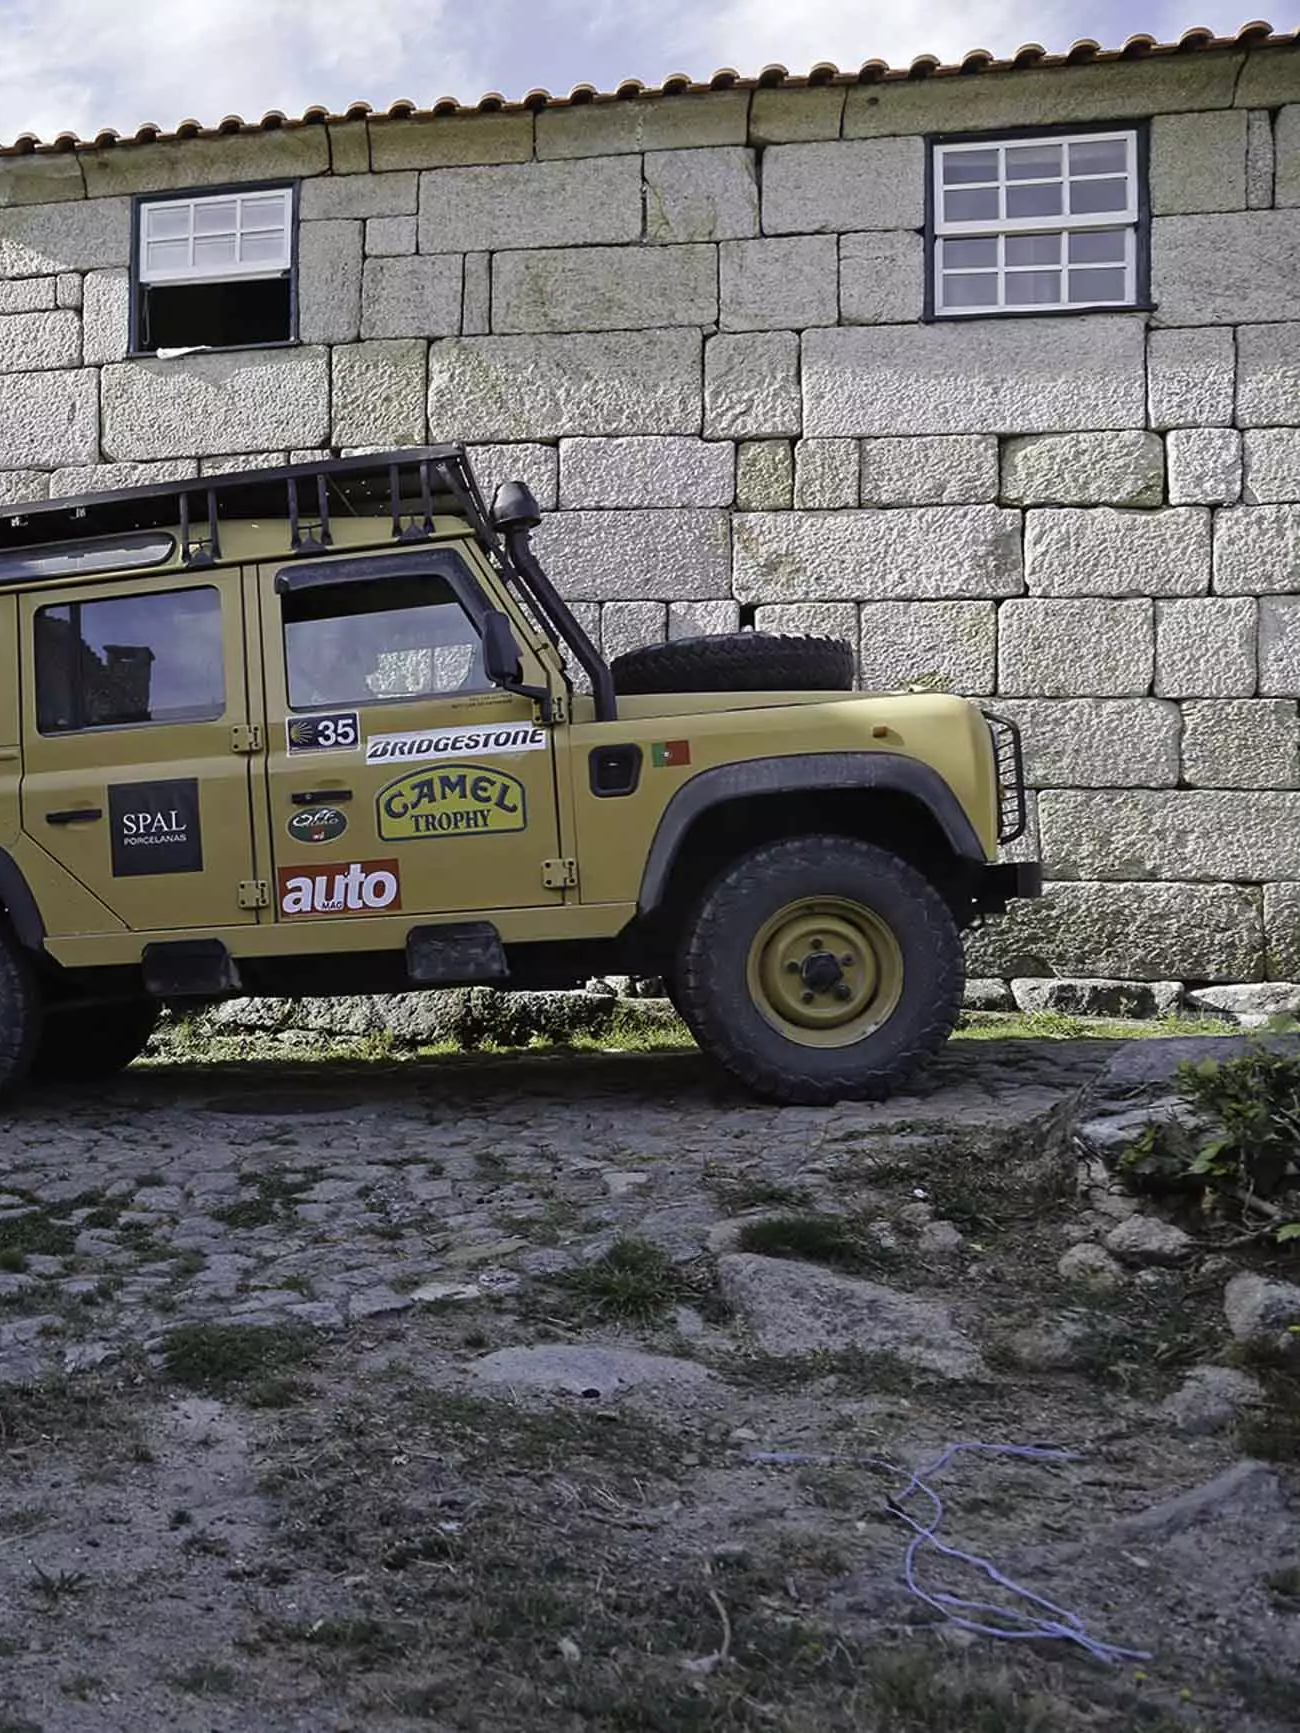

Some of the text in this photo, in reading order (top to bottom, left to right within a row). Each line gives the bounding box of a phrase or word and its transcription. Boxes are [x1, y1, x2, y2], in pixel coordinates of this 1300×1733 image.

[317, 719, 355, 746] 35
[367, 728, 546, 759] BRIDGESTONE
[384, 774, 518, 819] CAMEL
[123, 810, 187, 835] SPAL
[411, 809, 491, 833] TROPHY
[123, 834, 187, 846] PORCELANAS
[282, 863, 397, 913] auto
